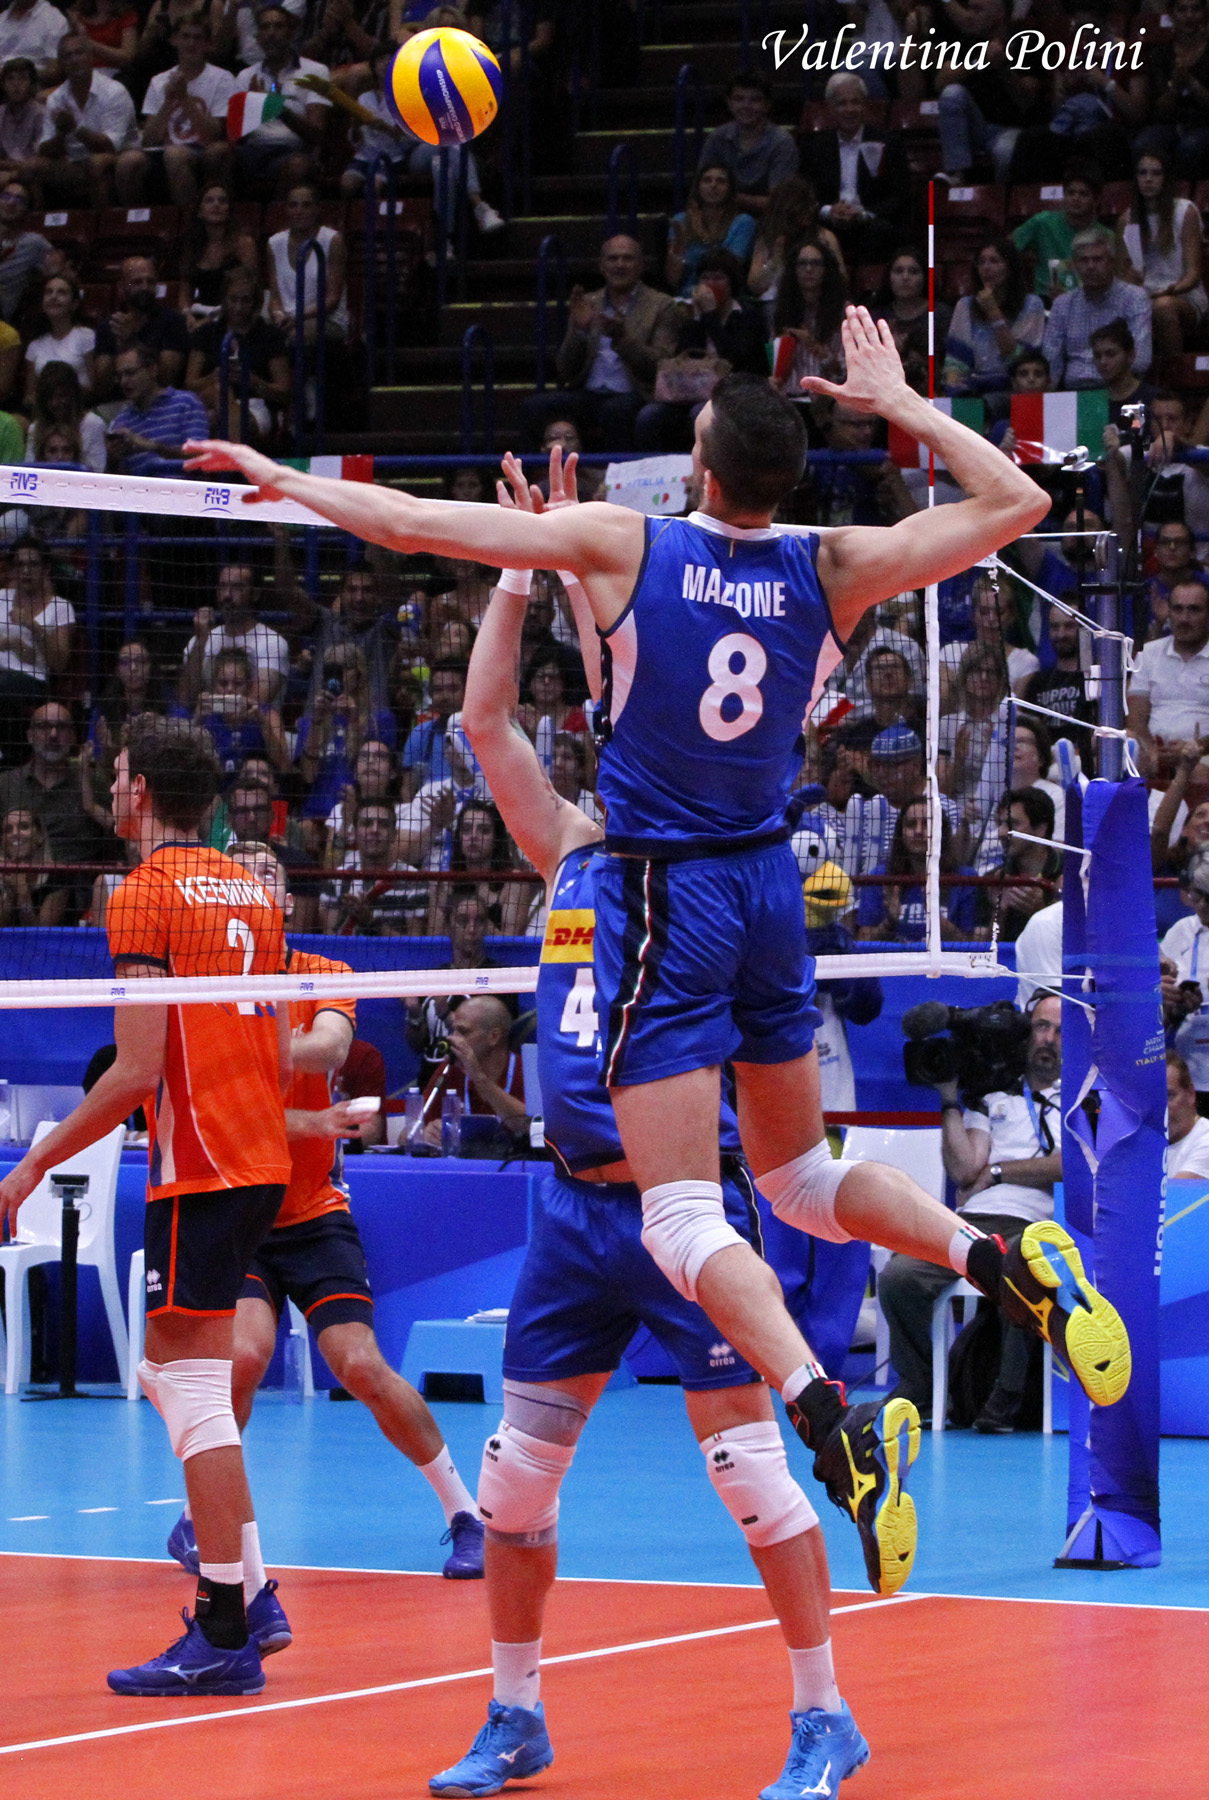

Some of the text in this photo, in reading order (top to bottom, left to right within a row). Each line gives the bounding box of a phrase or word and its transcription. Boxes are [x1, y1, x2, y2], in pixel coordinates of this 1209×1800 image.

[436, 69, 459, 122] CHAMPIONSHIP
[10, 472, 38, 491] FIVB
[204, 487, 231, 505] FIVB
[699, 632, 767, 742] 8
[559, 967, 599, 1047] 4
